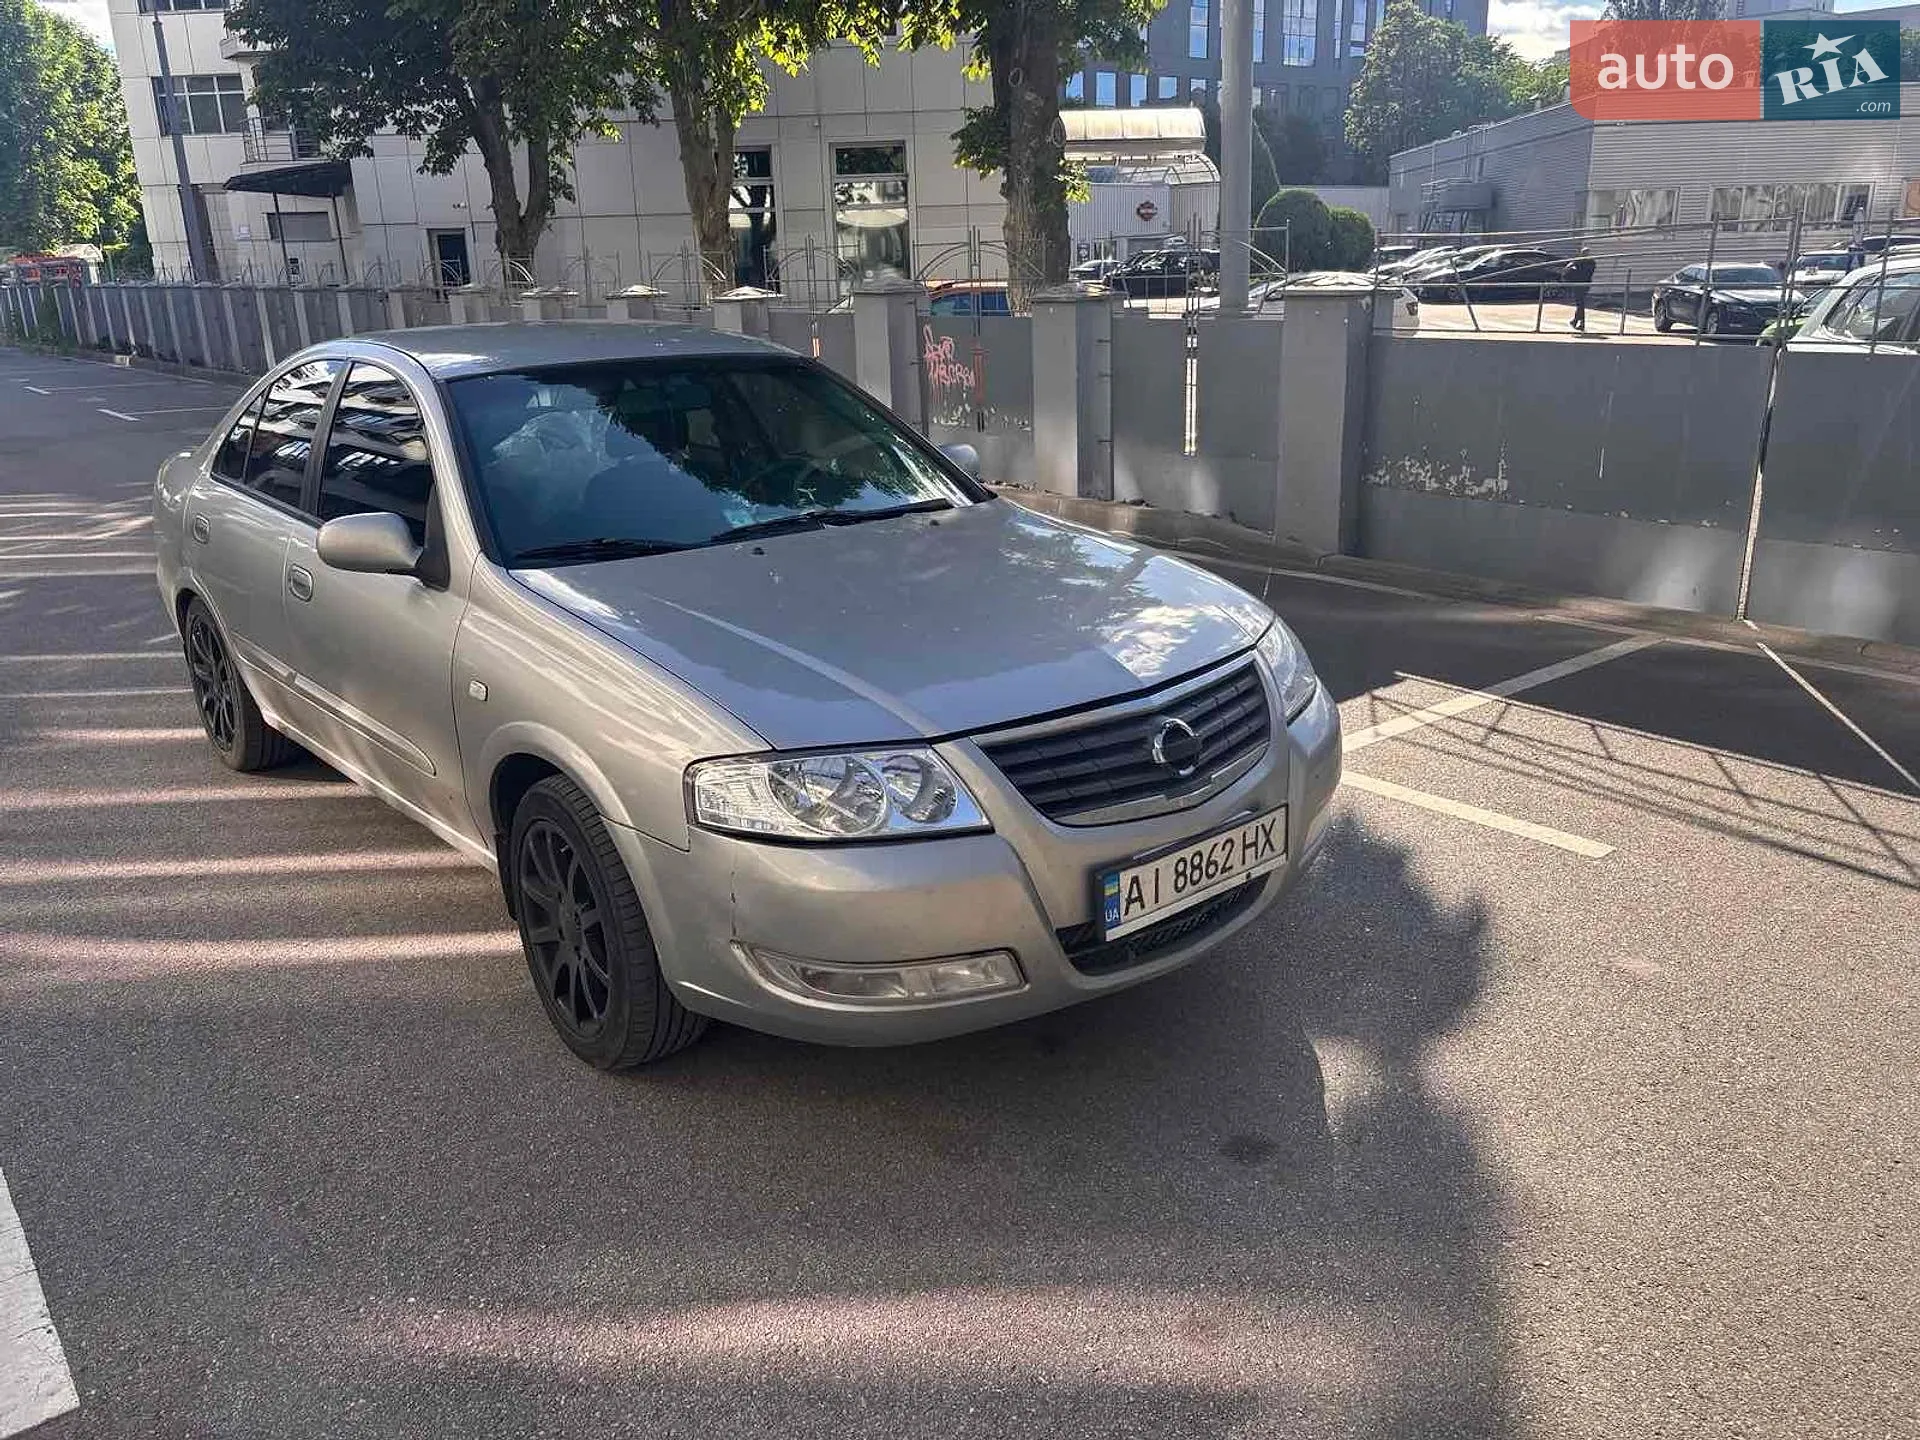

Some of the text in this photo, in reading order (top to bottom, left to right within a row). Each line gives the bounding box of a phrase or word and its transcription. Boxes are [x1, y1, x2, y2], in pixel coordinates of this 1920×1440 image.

[1123, 817, 1277, 916] AI 8862 HX
[1104, 908, 1120, 922] UA
